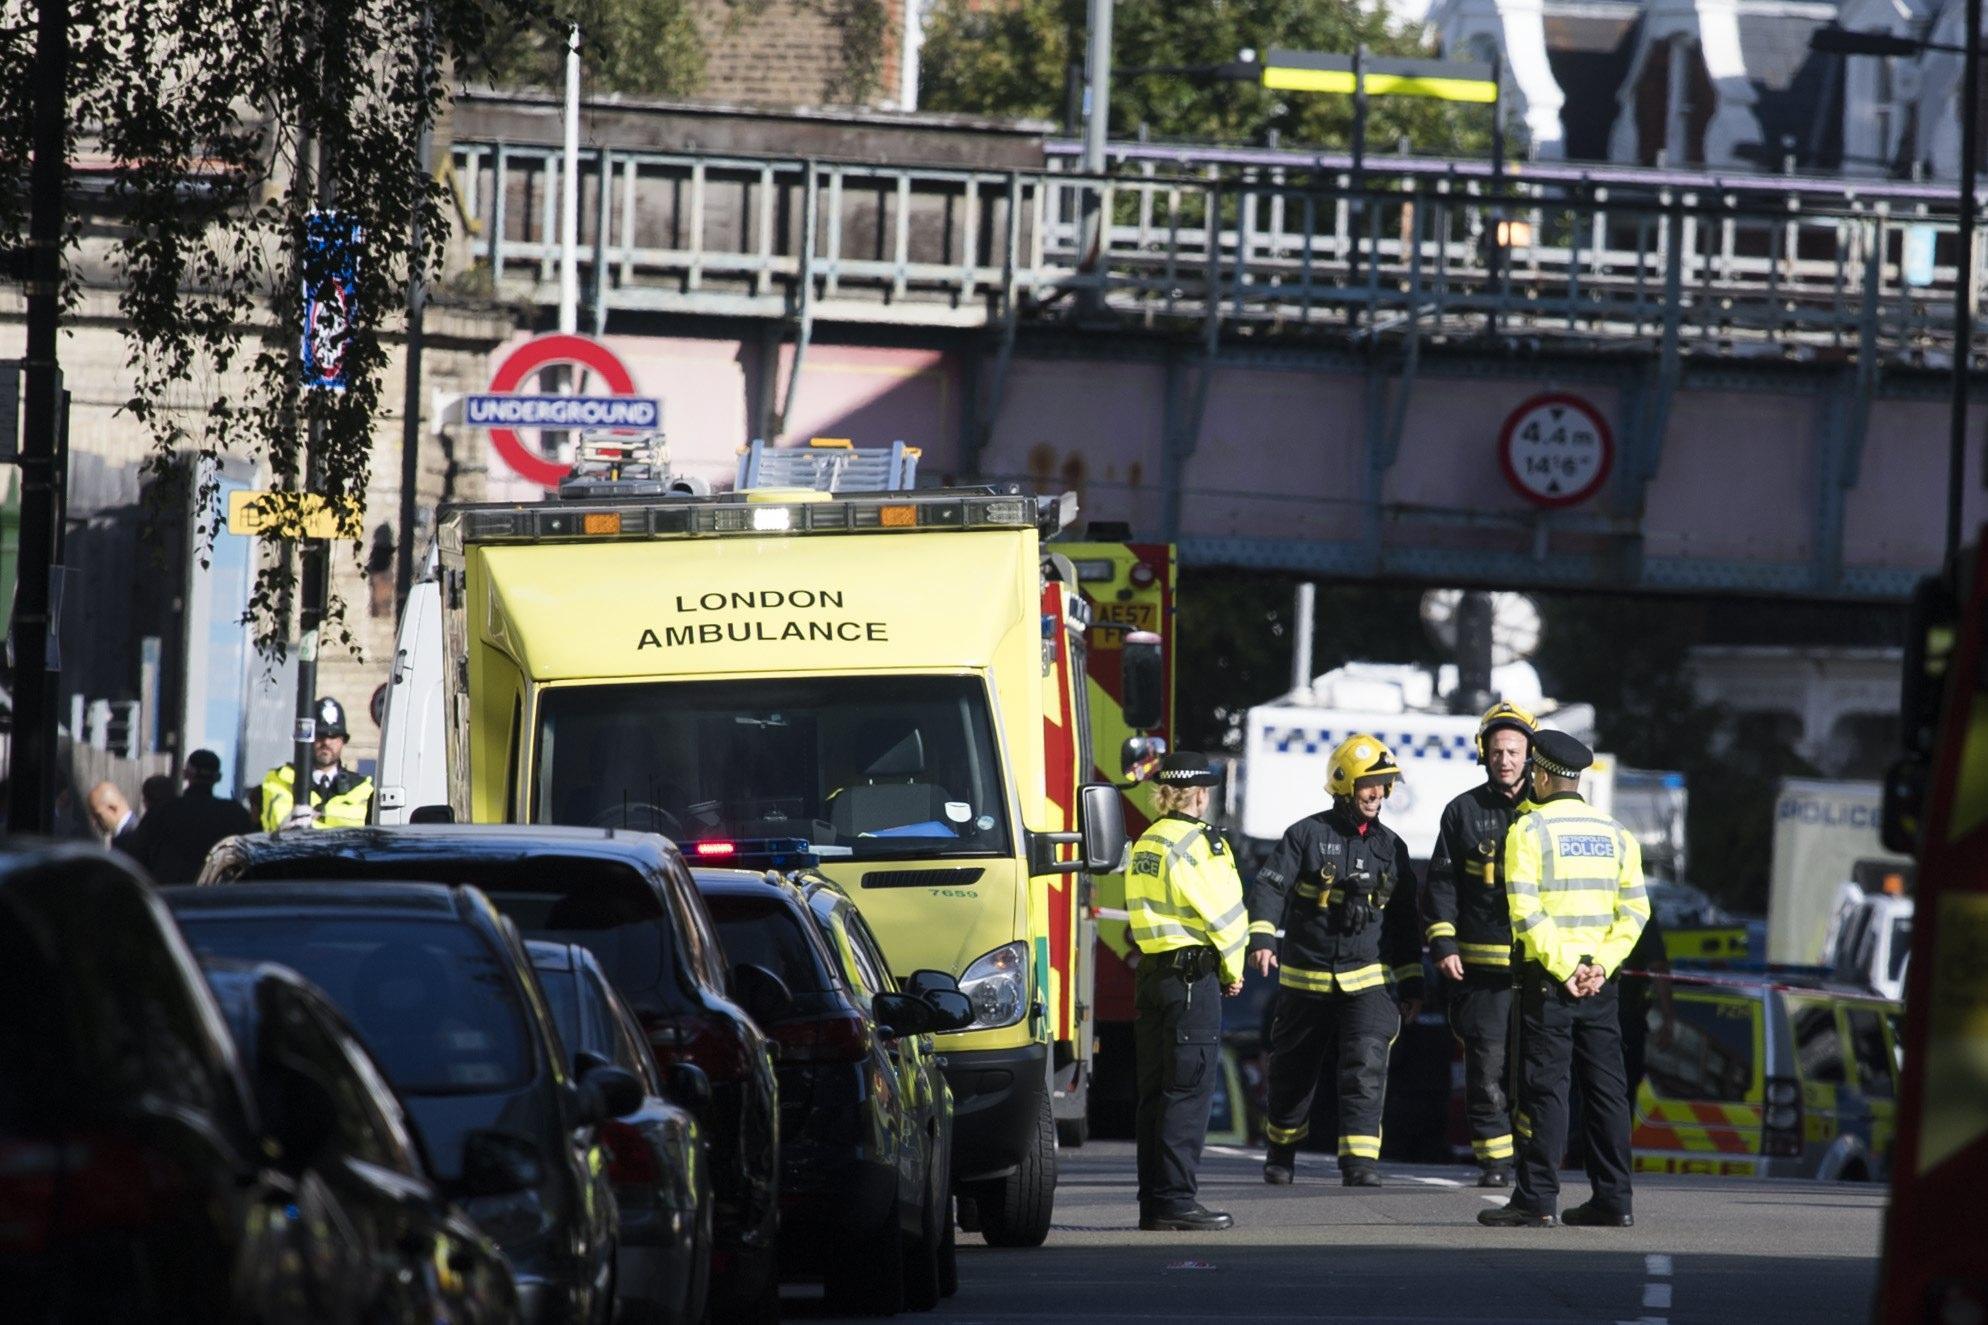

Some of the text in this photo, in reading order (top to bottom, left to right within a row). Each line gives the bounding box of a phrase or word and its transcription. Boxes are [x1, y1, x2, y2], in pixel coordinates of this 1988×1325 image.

[470, 399, 655, 425] UNDERGROUND
[676, 590, 843, 613] LONDON
[1099, 604, 1151, 623] AE57
[637, 621, 888, 650] AMBULANCE
[1560, 842, 1614, 857] POLICE
[928, 888, 978, 899] 7659
